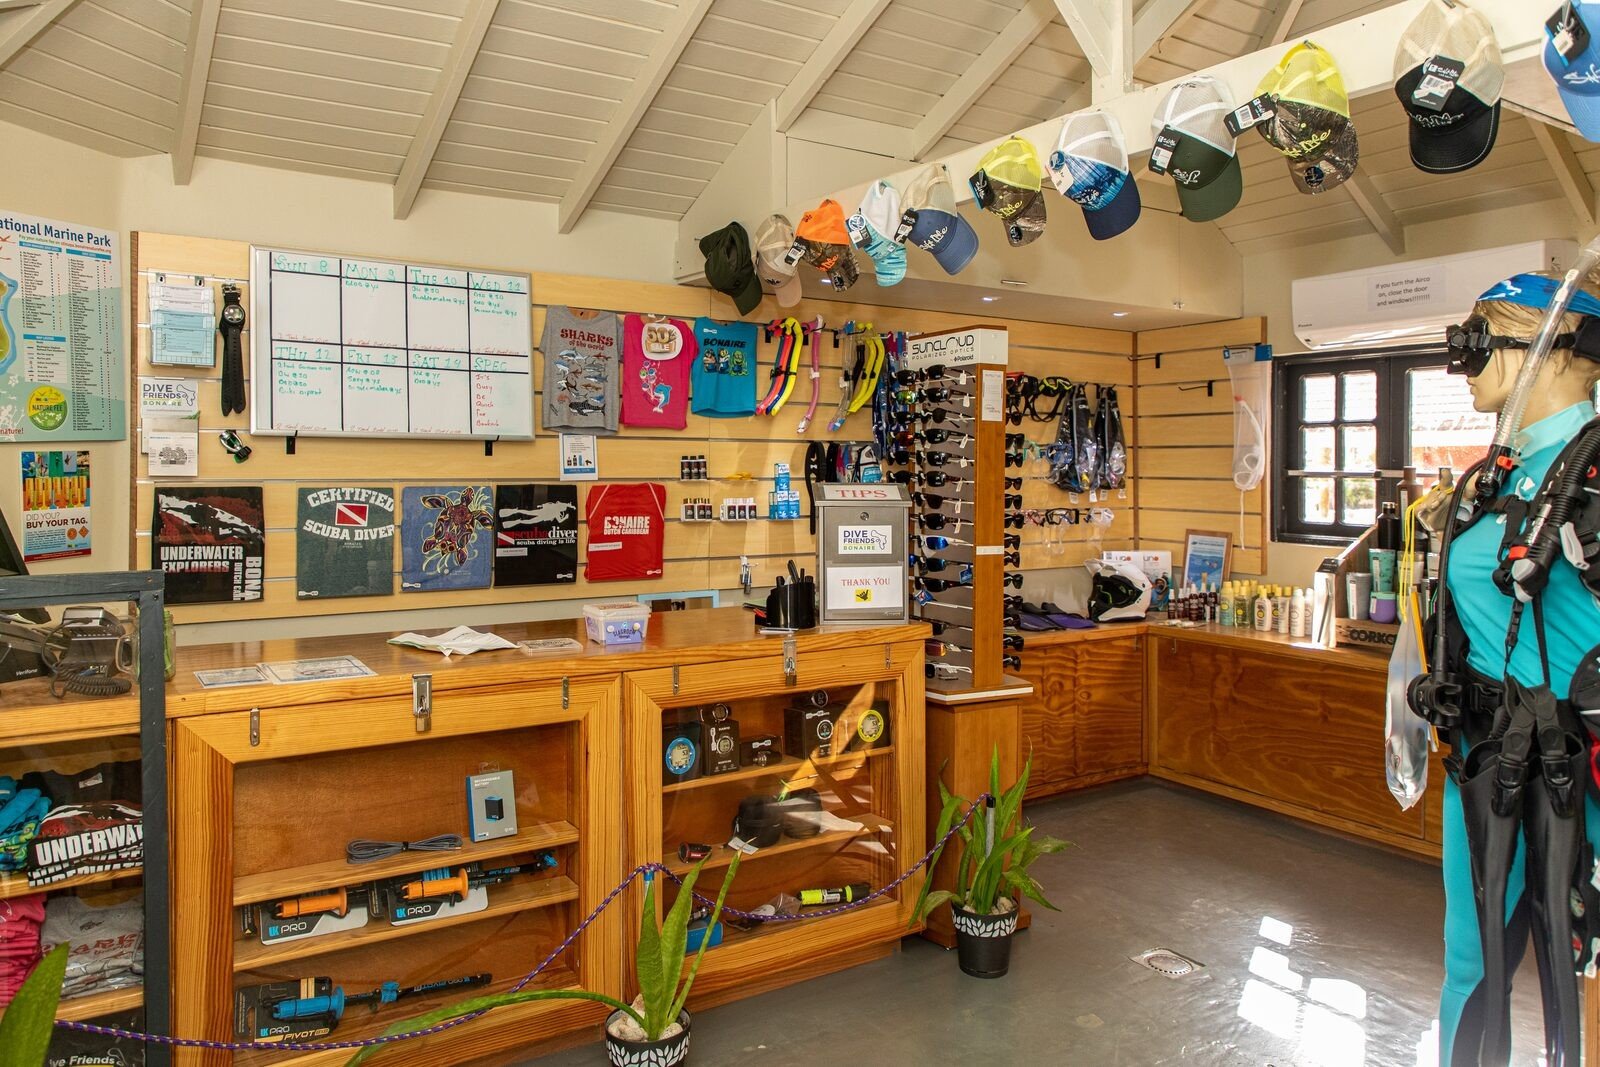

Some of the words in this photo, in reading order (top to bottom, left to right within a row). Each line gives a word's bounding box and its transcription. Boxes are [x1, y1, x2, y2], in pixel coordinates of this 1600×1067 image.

[44, 225, 84, 242] Marine
[87, 232, 111, 247] Park
[560, 328, 614, 347] SHARKS
[587, 343, 605, 351] world
[703, 338, 746, 349] BONAIRE
[912, 334, 975, 355] SUNCLOUD
[347, 349, 371, 363] FRI
[911, 351, 947, 360] POLARIZED
[949, 346, 975, 355] OPTICS
[413, 354, 440, 369] SAT
[474, 357, 507, 372] SPEC
[143, 383, 173, 392] DIVE
[835, 489, 888, 498] TIPS
[307, 487, 394, 512] CERTIFIED
[41, 512, 60, 520] YOU?
[46, 519, 69, 527] YOUR
[71, 517, 88, 525] TAG.
[303, 519, 350, 541] SCUBA
[354, 524, 394, 541] DIVER
[843, 530, 868, 538] DIVE
[160, 545, 244, 561] UNDERWATER
[162, 561, 230, 573] EXPLORERS
[841, 578, 872, 587] THANK
[873, 577, 891, 586] YOU
[407, 905, 432, 916] PRO
[280, 921, 307, 933] PRO
[270, 1025, 290, 1035] PRO
[284, 1030, 315, 1041] PIVOT
[68, 1055, 115, 1066] Friends
